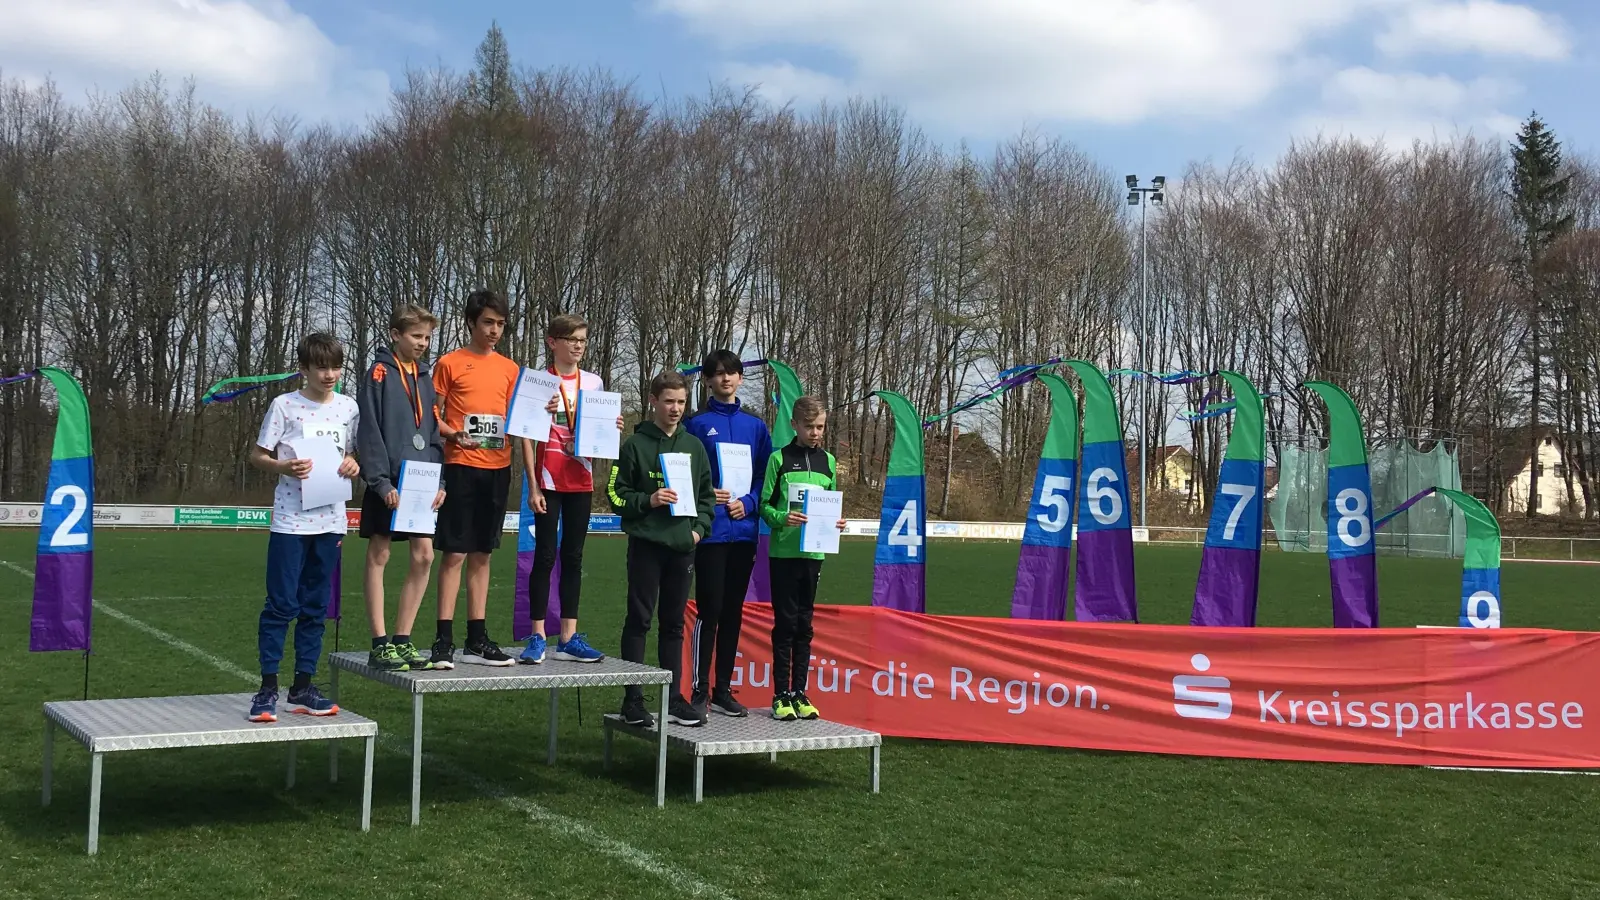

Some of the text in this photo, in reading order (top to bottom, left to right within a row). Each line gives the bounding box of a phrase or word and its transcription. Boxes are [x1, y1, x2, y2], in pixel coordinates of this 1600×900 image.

[524, 375, 558, 389] URKUNDE
[585, 397, 619, 406] URKUNDE
[408, 468, 439, 478] URKUNDE
[798, 490, 805, 500] 5
[1087, 467, 1123, 525] 6
[50, 485, 88, 546] 2
[237, 510, 267, 520] DEVK
[1036, 475, 1072, 533] 5
[1221, 483, 1257, 540] 7
[1335, 488, 1371, 547] 8
[888, 500, 923, 557] 4
[960, 525, 1020, 538] PICHLMAY
[1467, 590, 1500, 628] 9
[729, 651, 770, 688] Gu
[871, 661, 935, 700] die
[950, 666, 1111, 715] Region.
[1258, 690, 1584, 737] Kreissparkasse
